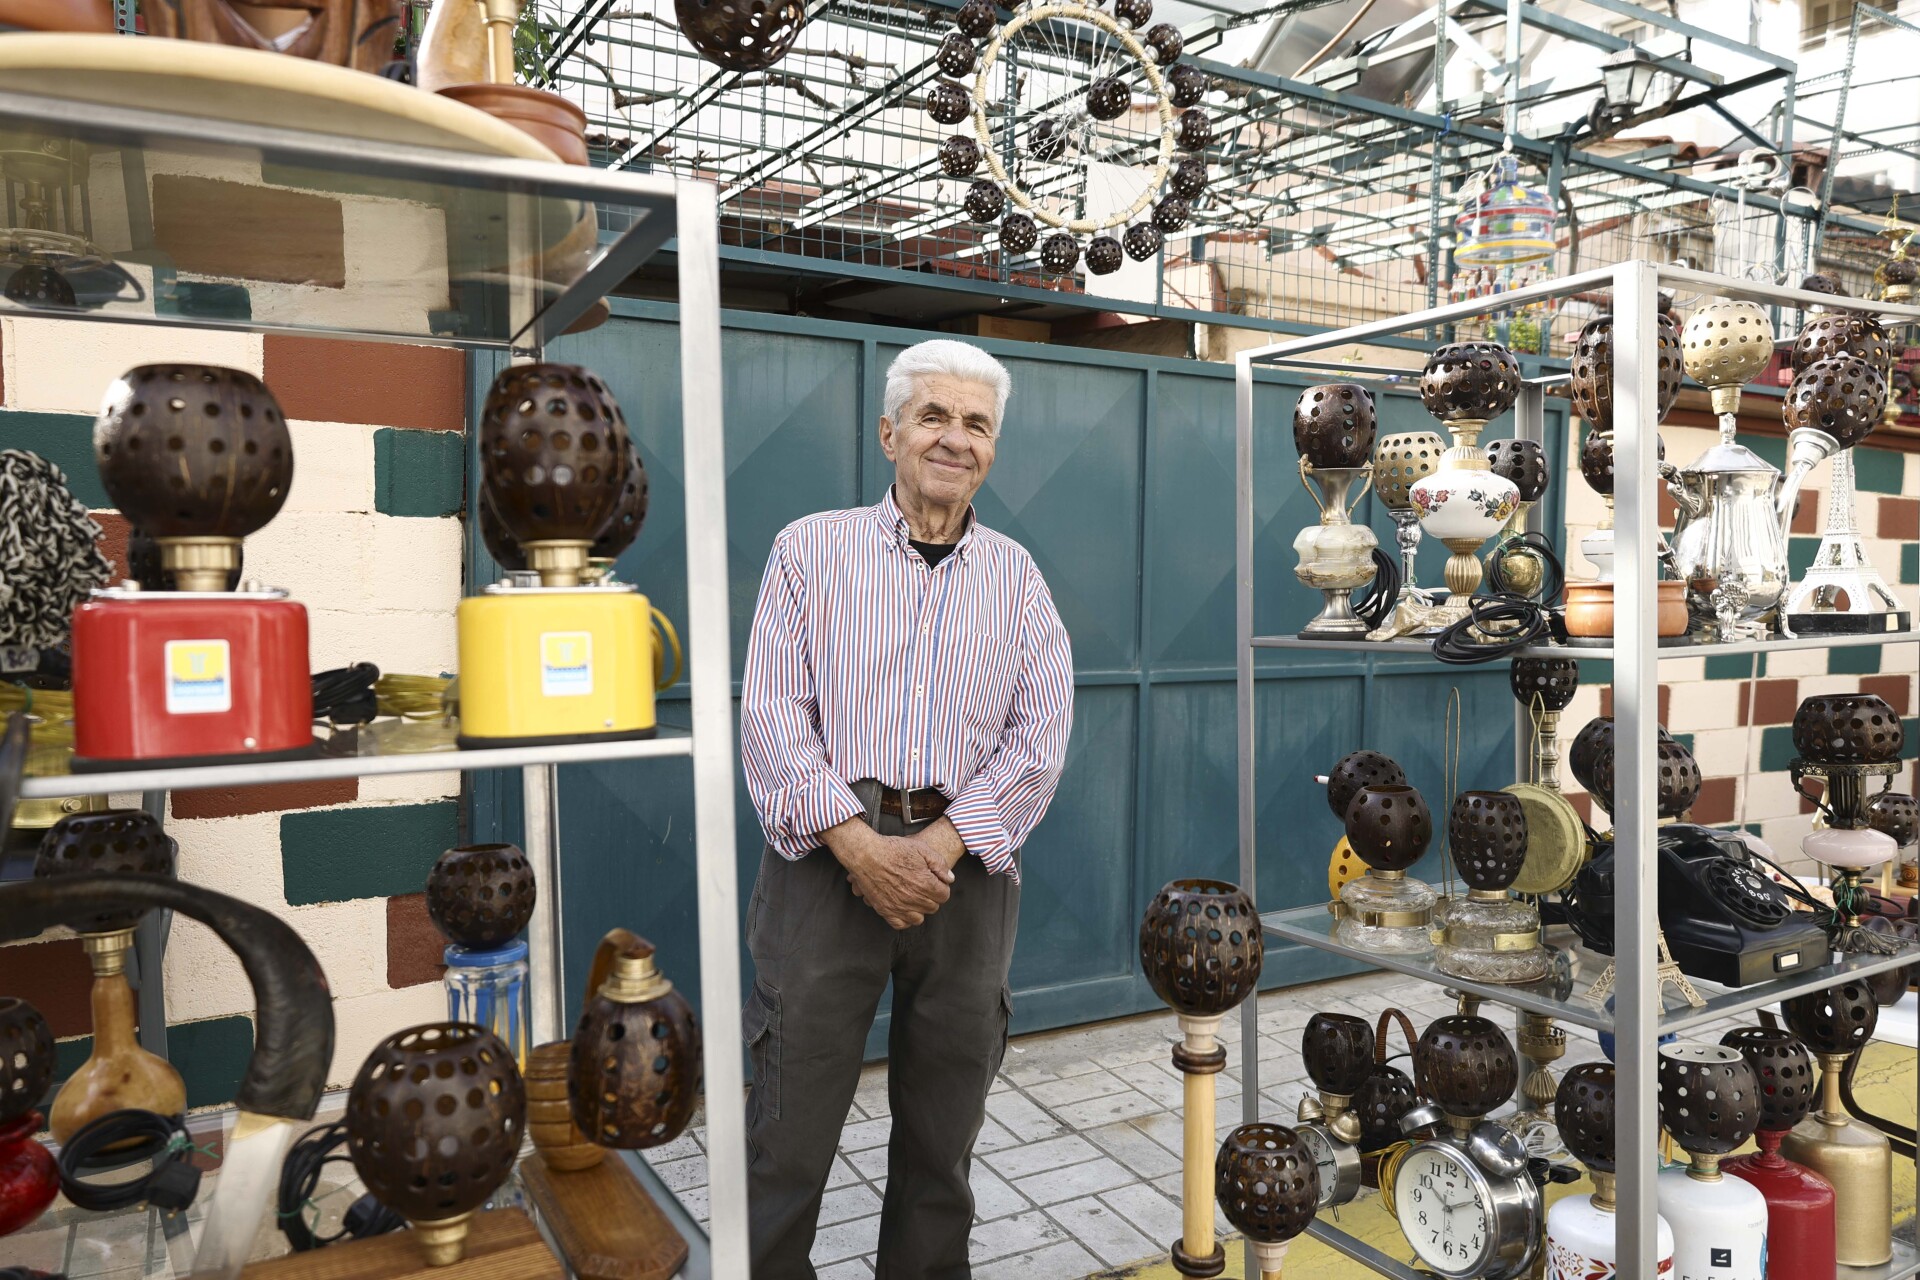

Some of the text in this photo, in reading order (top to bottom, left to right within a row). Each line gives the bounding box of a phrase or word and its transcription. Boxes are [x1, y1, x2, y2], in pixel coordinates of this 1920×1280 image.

[1430, 1161, 1442, 1178] 11
[1444, 1161, 1458, 1178] 12
[1418, 1173, 1433, 1190] 10
[1464, 1175, 1470, 1190] 1
[1413, 1188, 1423, 1203] 9
[1474, 1193, 1484, 1210] 2
[1418, 1210, 1428, 1226] 8
[1478, 1216, 1487, 1233] 3
[1431, 1229, 1440, 1244] 7
[1471, 1233, 1481, 1250] 4
[1443, 1240, 1453, 1257] 6
[1459, 1242, 1469, 1260] 5
